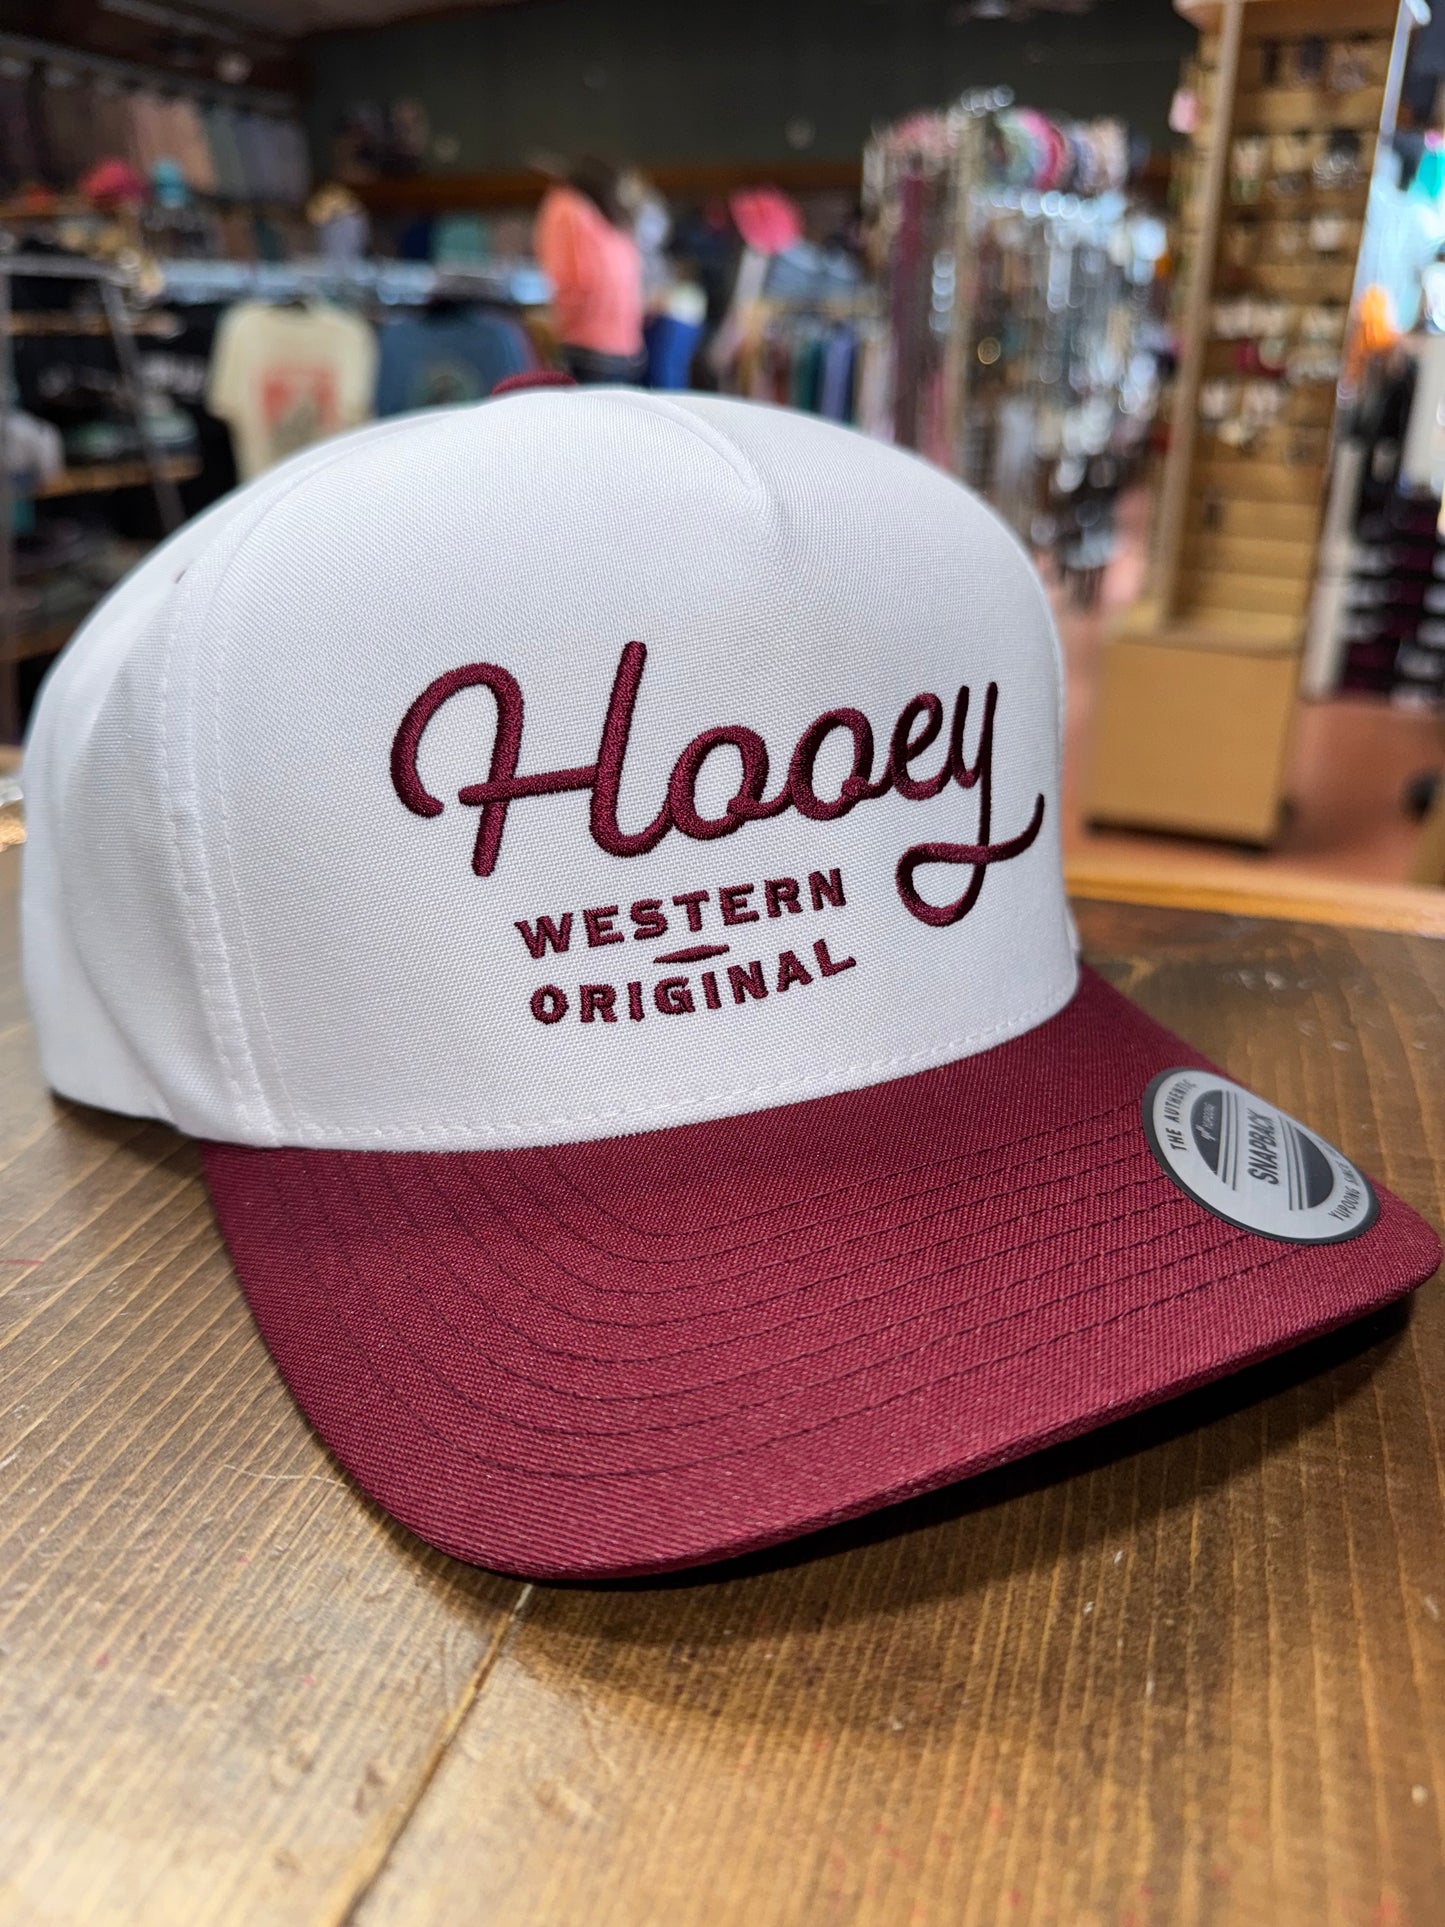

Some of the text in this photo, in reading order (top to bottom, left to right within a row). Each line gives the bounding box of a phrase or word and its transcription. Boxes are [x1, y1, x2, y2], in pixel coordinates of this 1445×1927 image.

[390, 641, 1045, 926] Hooey
[514, 868, 846, 959] WESTERN
[529, 939, 856, 1024] ORIGINAL
[1163, 1078, 1197, 1151] THE AUTHENTIC
[1246, 1107, 1279, 1185] SNAPBACK
[1327, 1185, 1361, 1221] YUPOONG
